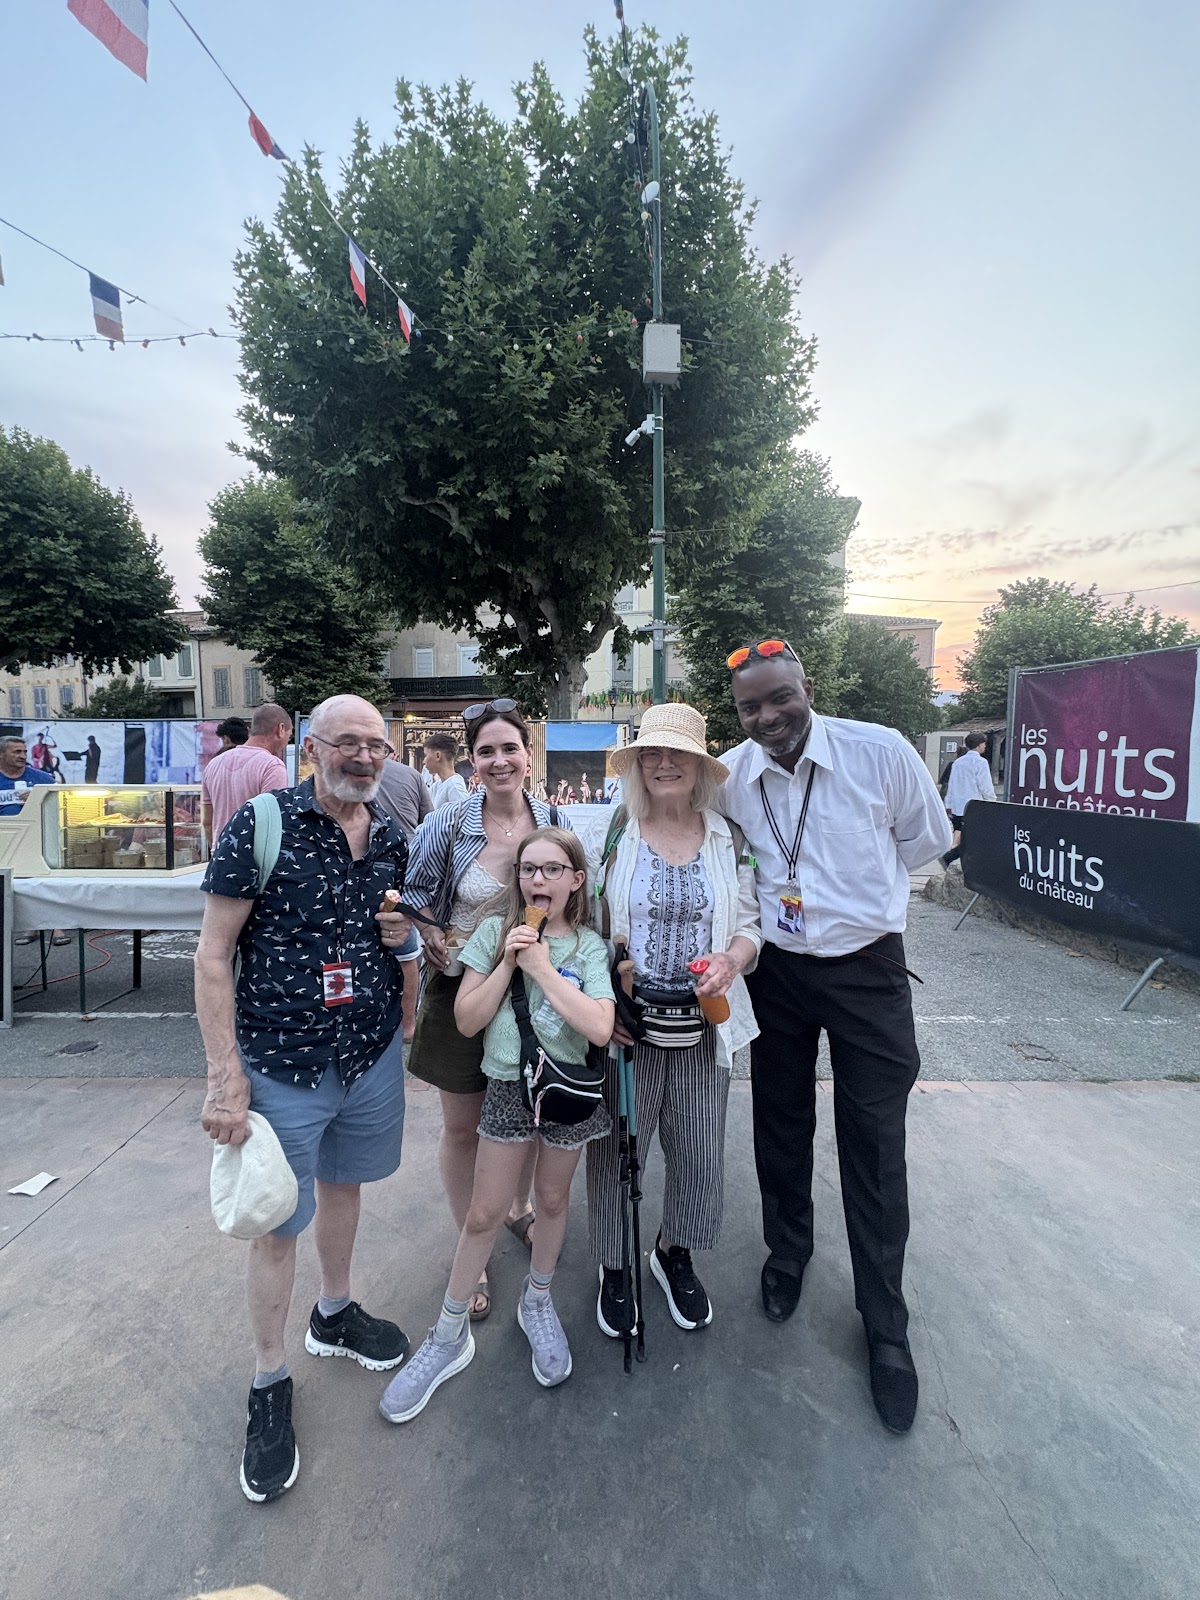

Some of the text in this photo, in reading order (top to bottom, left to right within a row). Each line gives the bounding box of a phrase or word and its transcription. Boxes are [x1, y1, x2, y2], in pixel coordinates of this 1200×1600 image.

[1020, 723, 1048, 746] les
[1018, 730, 1176, 801] nuits
[1014, 824, 1031, 843] les
[1013, 838, 1104, 892] nuits
[1019, 872, 1094, 910] du château
